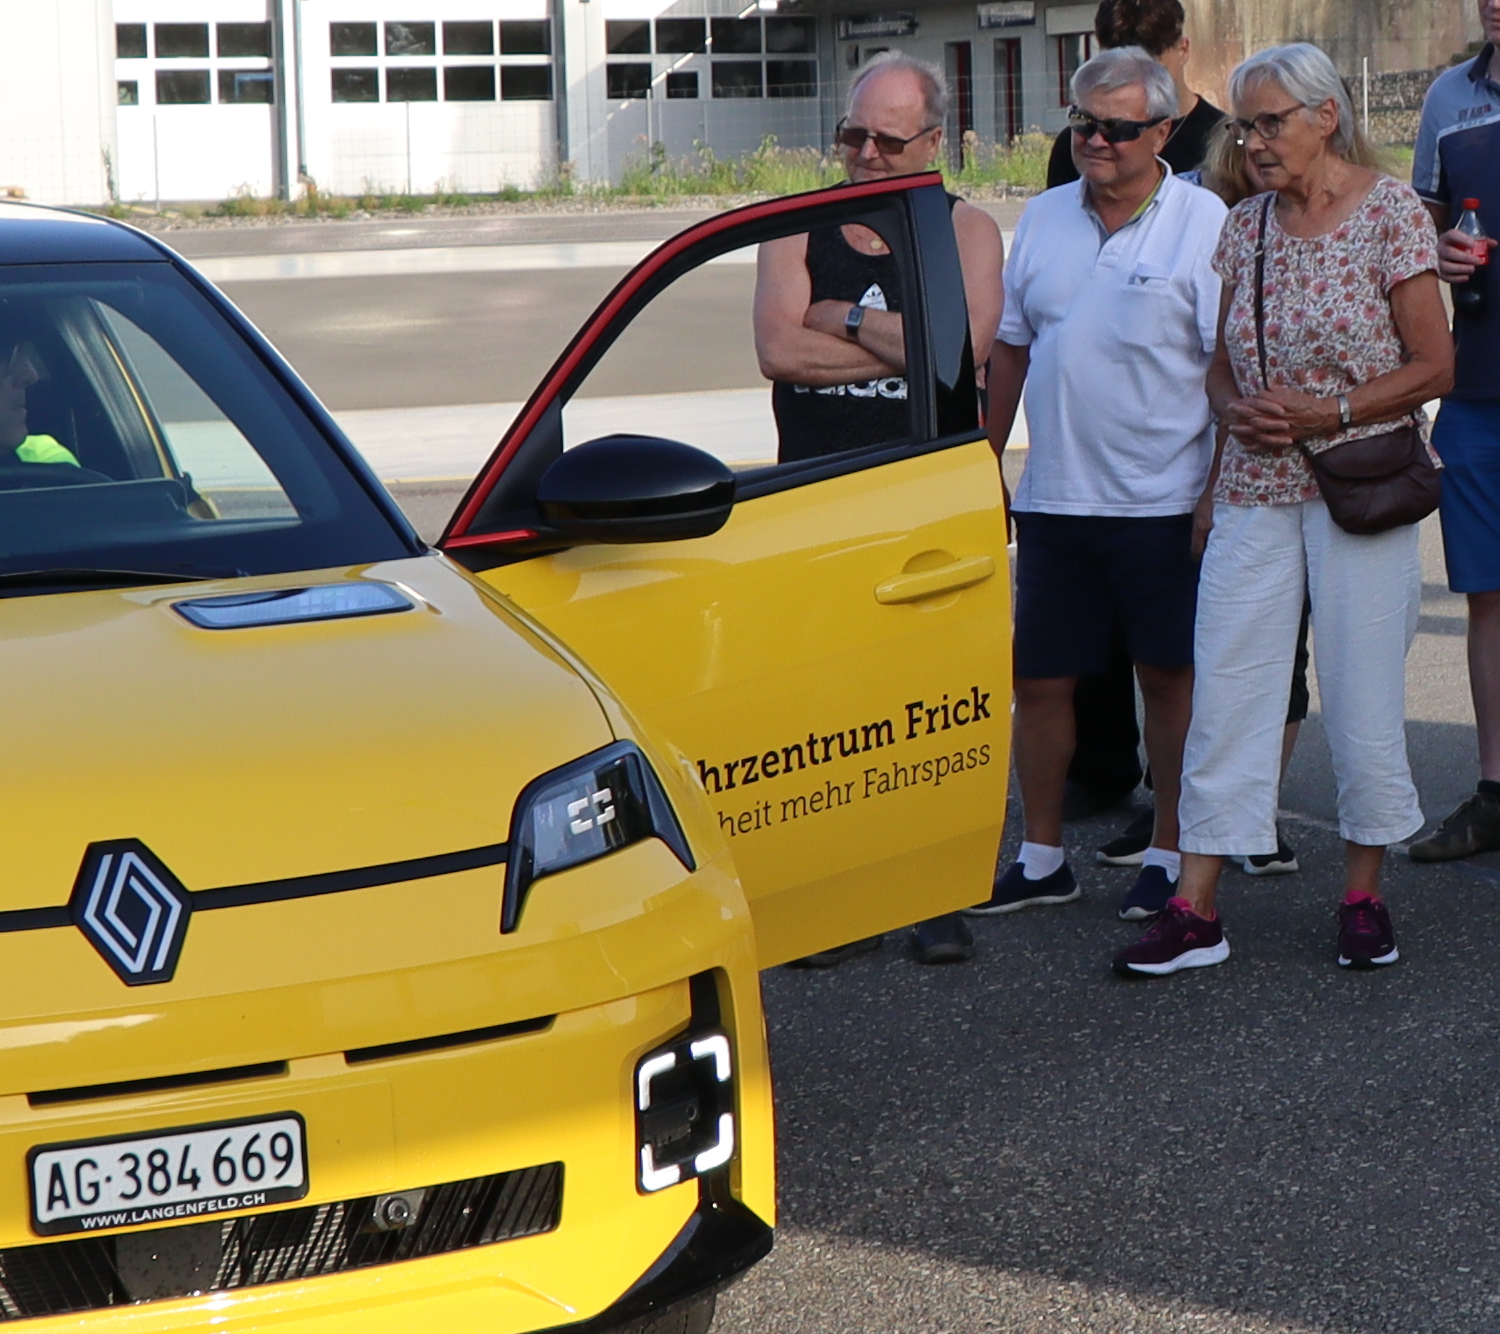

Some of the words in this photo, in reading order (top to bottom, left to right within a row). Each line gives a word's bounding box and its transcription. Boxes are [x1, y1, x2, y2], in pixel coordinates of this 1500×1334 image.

[696, 718, 895, 796] hrzentrum
[905, 685, 991, 741] Frick
[780, 780, 856, 823] mehr
[862, 743, 991, 800] Fahrspass
[81, 1192, 266, 1229] WWW.LANGENFELD.CH
